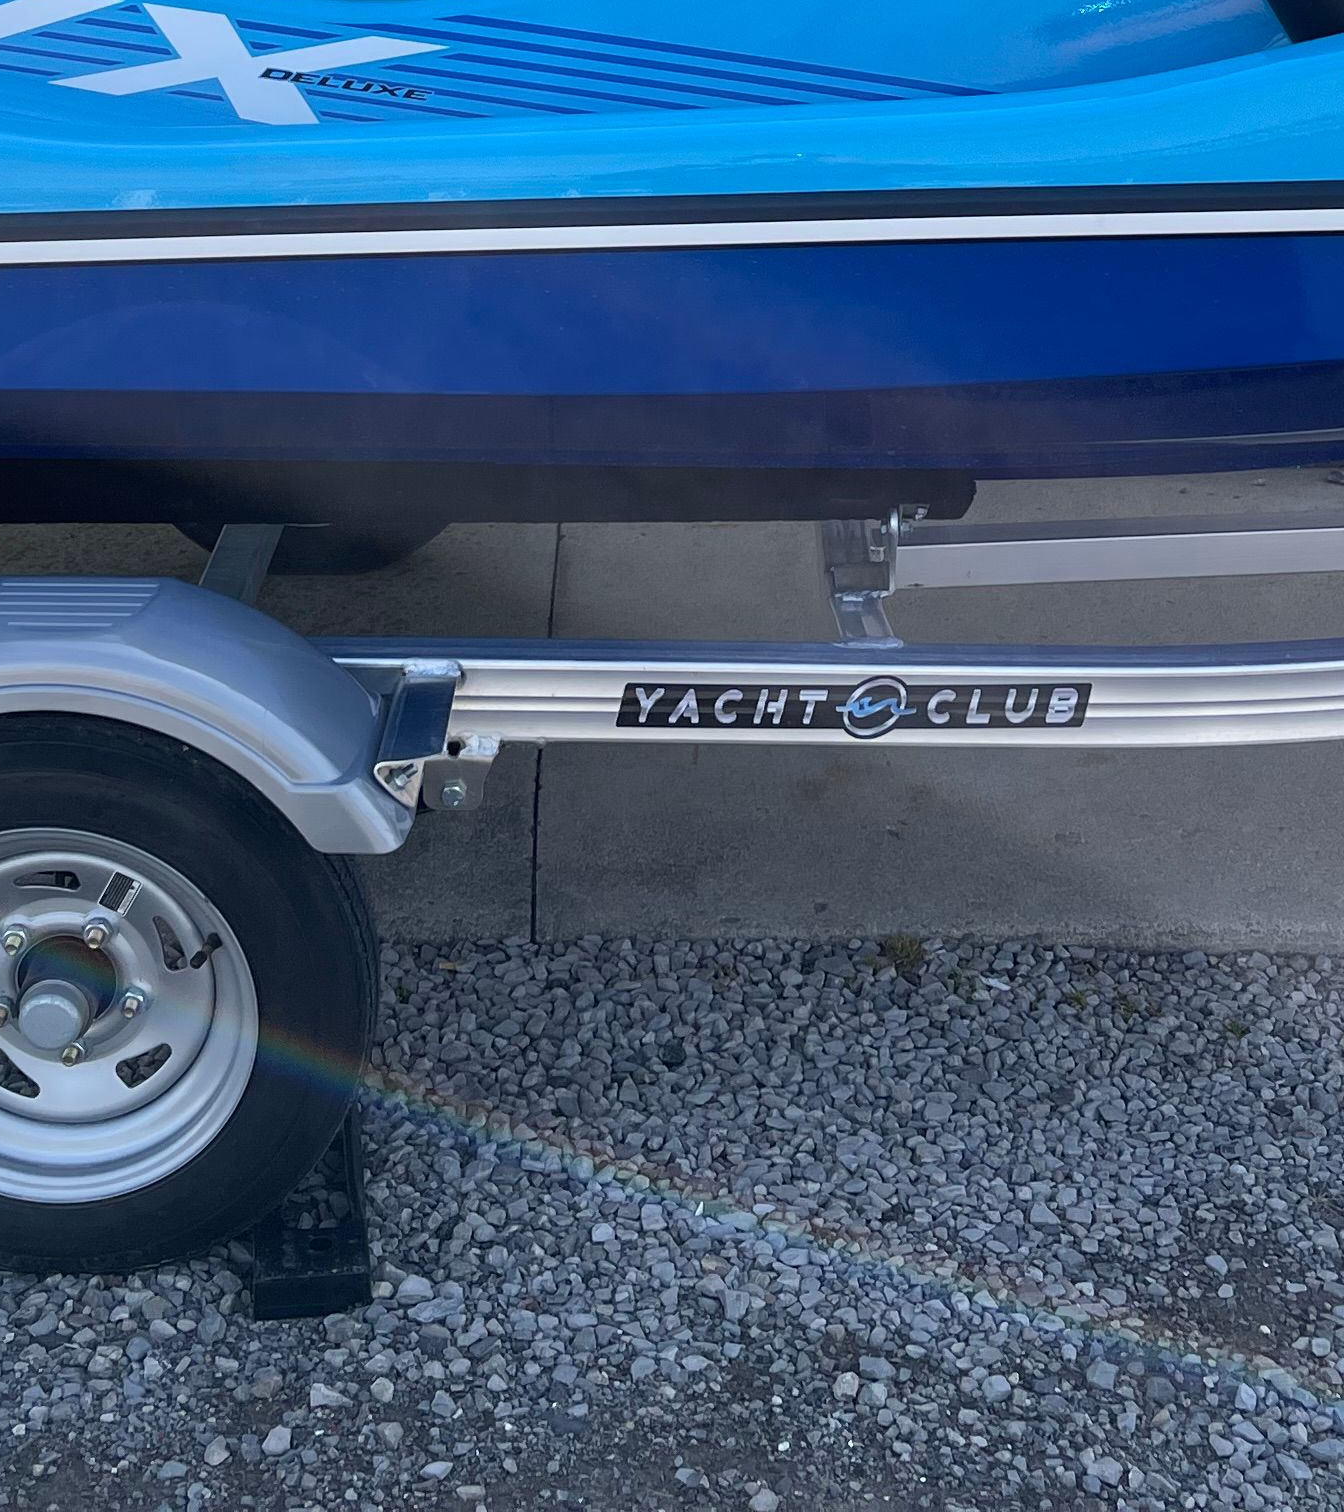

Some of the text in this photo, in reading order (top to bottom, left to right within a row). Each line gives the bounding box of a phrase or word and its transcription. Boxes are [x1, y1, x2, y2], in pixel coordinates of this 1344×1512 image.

[258, 67, 434, 102] DELUXE
[634, 687, 1080, 725] YACHT CLUB
